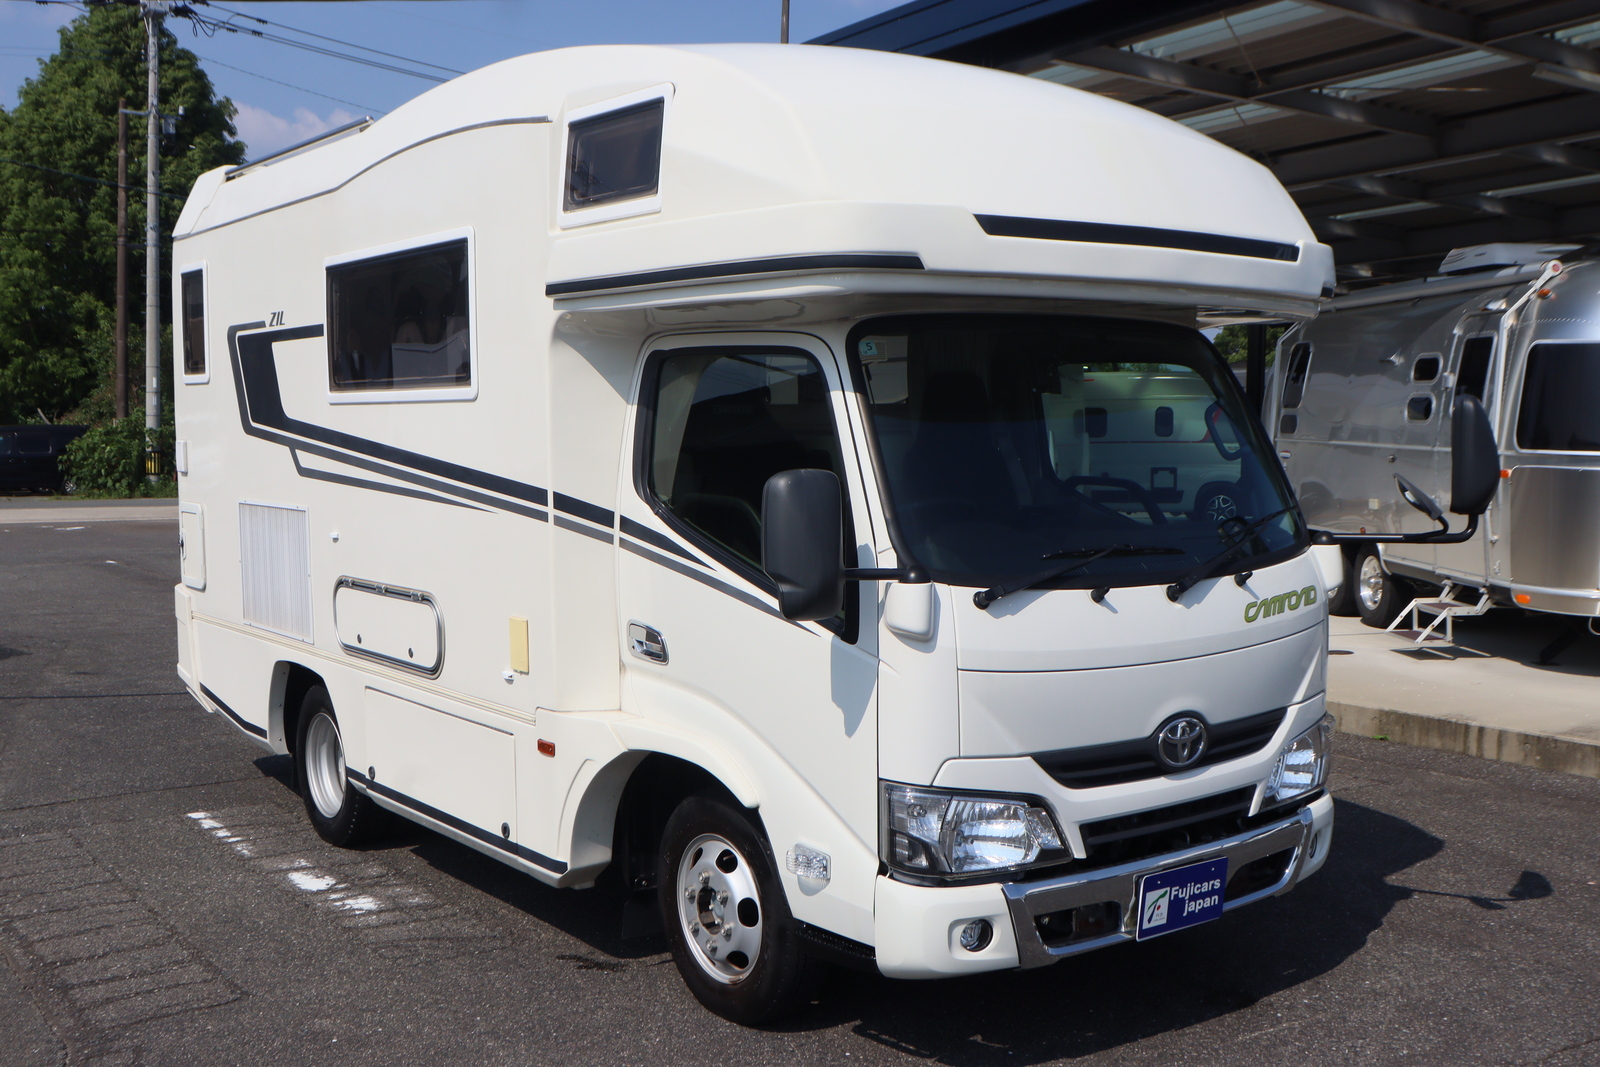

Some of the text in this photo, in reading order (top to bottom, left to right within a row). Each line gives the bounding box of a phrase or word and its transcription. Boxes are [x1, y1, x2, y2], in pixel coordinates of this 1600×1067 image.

[269, 310, 285, 327] ZIL
[865, 342, 873, 351] 5
[1170, 879, 1221, 900] Fujicars
[1183, 895, 1219, 917] japan
